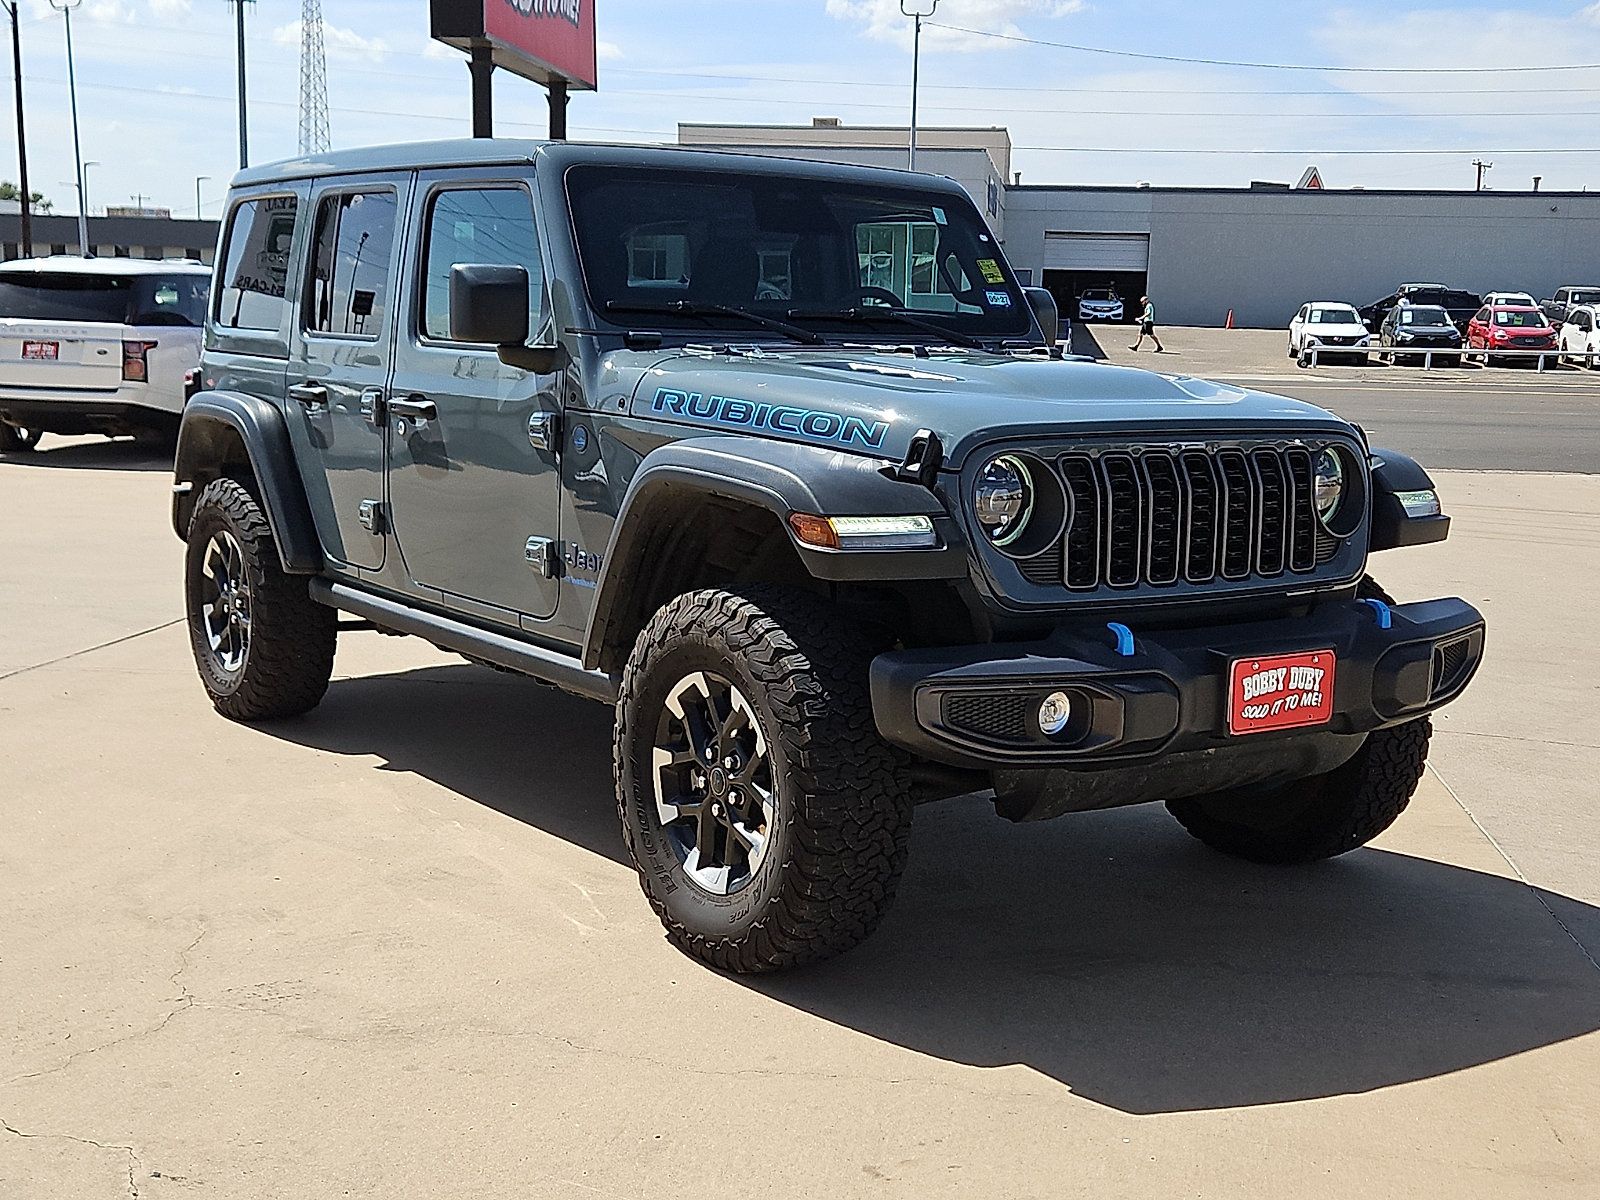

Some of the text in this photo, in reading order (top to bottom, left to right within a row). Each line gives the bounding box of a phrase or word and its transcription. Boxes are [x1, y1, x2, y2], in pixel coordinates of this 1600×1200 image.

[652, 387, 889, 448] RUBICON
[1242, 666, 1325, 701] BOBBY DUBY
[1241, 691, 1323, 719] SOLD IT TO ME!
